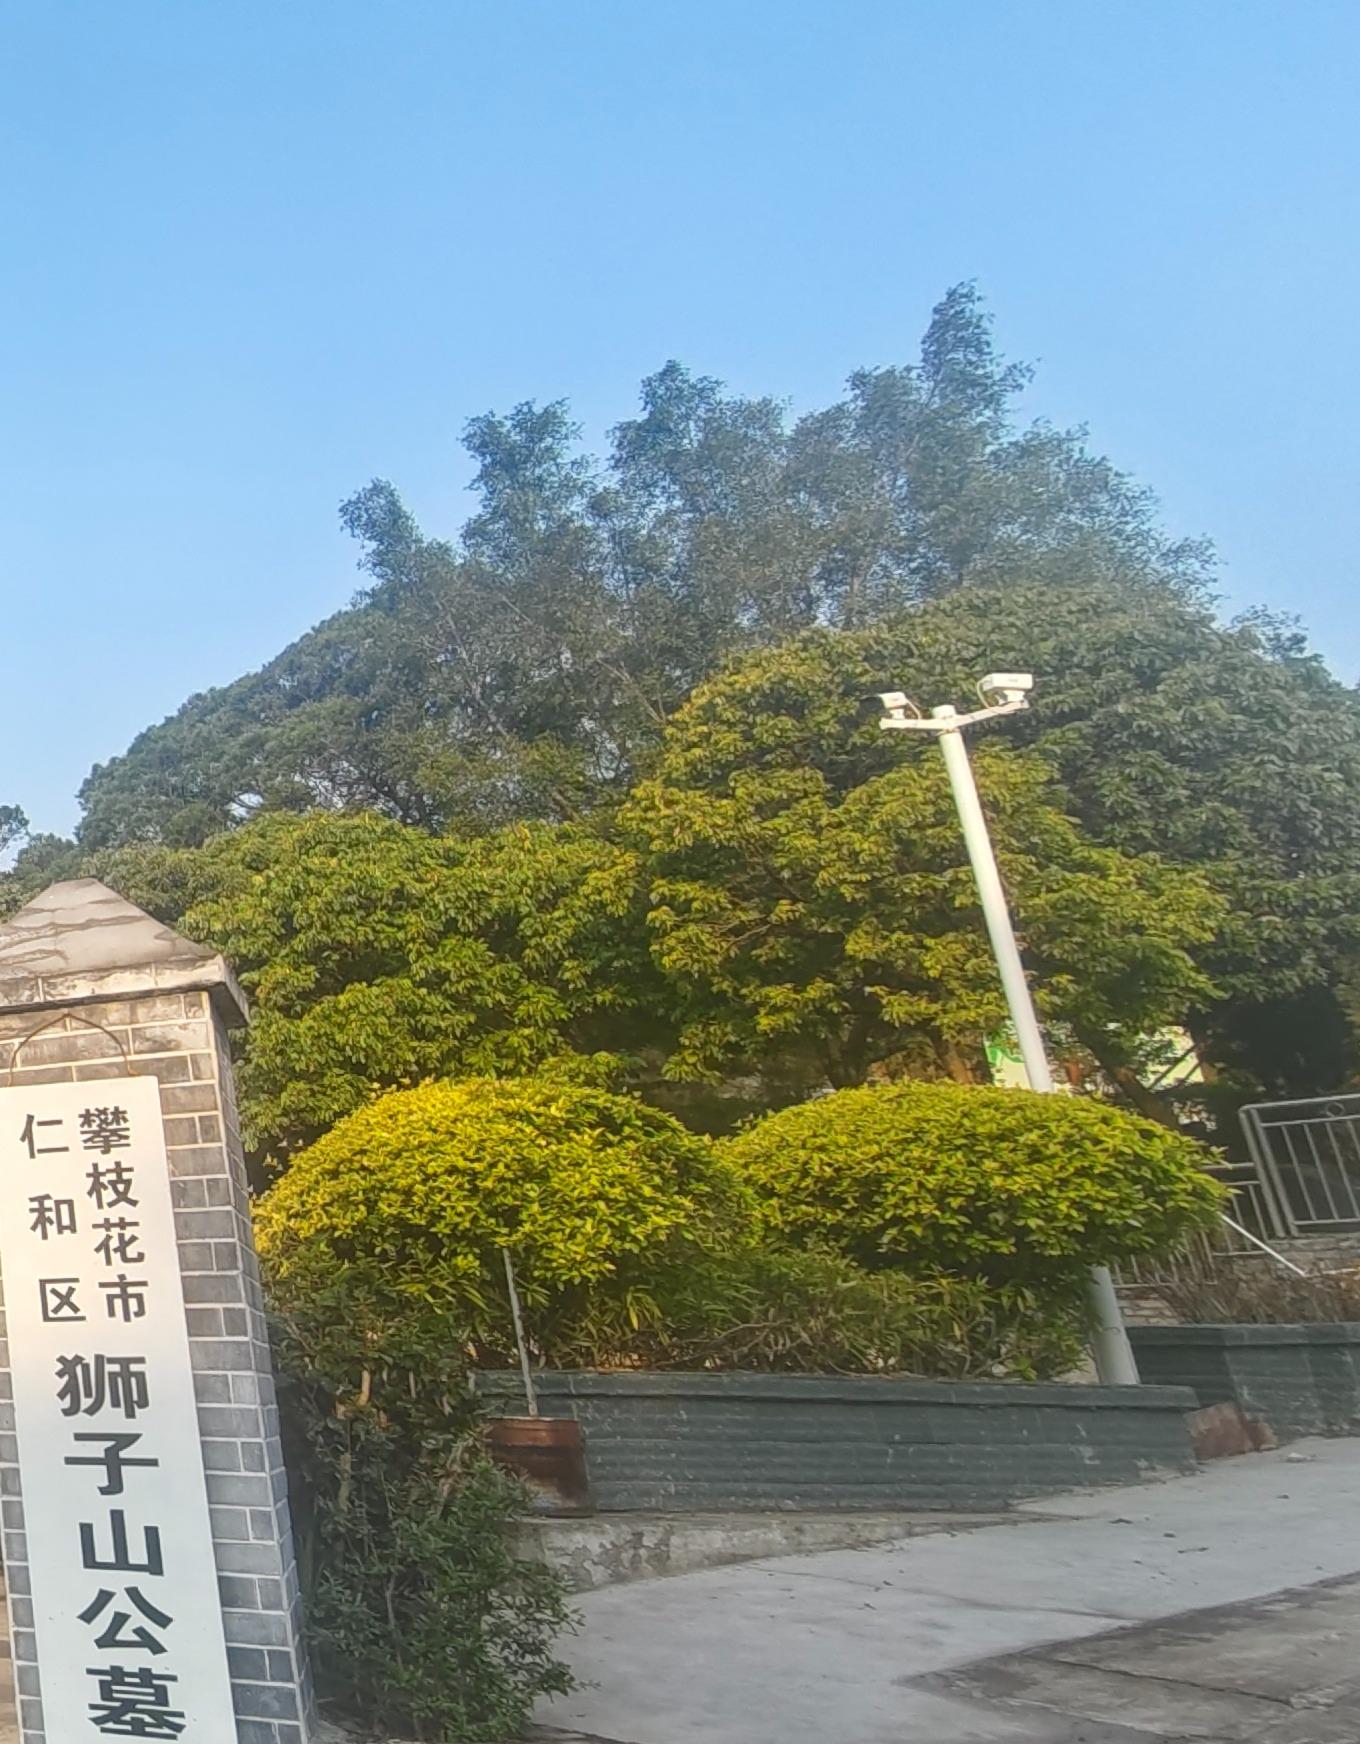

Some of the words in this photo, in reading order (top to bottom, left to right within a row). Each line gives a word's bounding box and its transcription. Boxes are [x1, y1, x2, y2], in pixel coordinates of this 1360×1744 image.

[19, 1113, 87, 1323] 仁和区
[78, 1105, 149, 1323] 攀枝花市
[54, 1352, 187, 1741] 狮子山公墓
